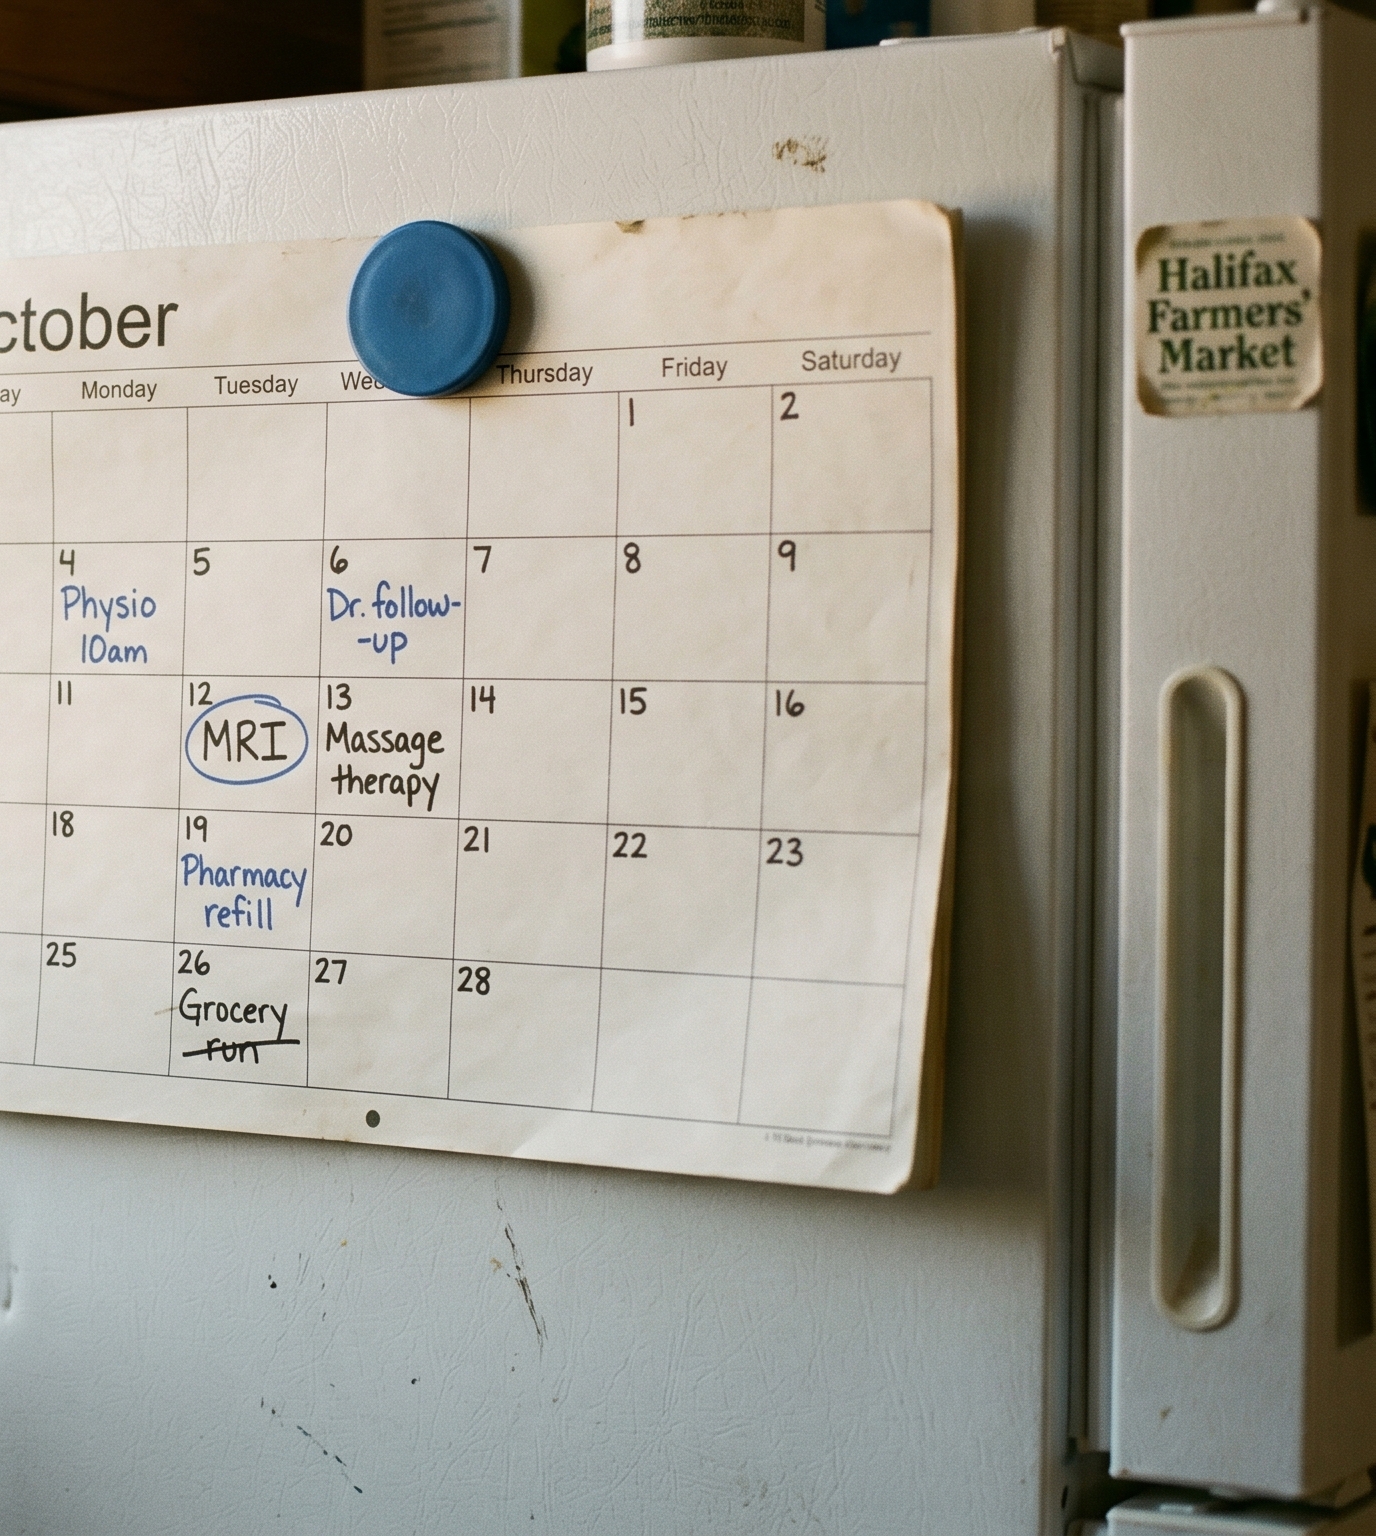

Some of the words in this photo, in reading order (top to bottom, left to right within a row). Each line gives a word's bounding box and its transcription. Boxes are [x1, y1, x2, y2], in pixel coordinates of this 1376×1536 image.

[1159, 250, 1298, 292] Halifax
[1147, 288, 1312, 334] Farmers'
[1158, 332, 1297, 374] Market
[81, 380, 157, 402] Monday
[214, 375, 299, 397] Tuesday
[496, 362, 593, 386] Thursday
[661, 356, 728, 380] Friday
[801, 347, 902, 373] Saturday
[628, 397, 635, 427] 1
[781, 391, 799, 420] 2
[59, 550, 75, 576] 4
[193, 547, 210, 576] 5
[330, 545, 348, 574] 6
[473, 546, 491, 573] 7
[624, 542, 641, 574] 8
[778, 540, 796, 571] 9
[61, 585, 156, 632] Physio
[327, 588, 365, 621] Dr.
[372, 580, 461, 619] follow-
[82, 634, 147, 663] 10am
[358, 632, 408, 664] -up
[58, 681, 72, 705] 11
[189, 681, 213, 706] 12
[328, 683, 352, 710] 13
[471, 685, 496, 714] 14
[621, 687, 647, 715] 15
[776, 690, 805, 717] 16
[204, 720, 287, 762] MRI
[326, 721, 445, 770] Massage
[331, 763, 440, 812] therapy
[53, 810, 74, 837] 18
[186, 815, 207, 842] 19
[320, 821, 353, 846] 20
[464, 826, 489, 853] 21
[613, 831, 647, 858] 22
[767, 837, 803, 867] 23
[181, 853, 307, 908] Pharmacy
[205, 894, 272, 930] refill
[46, 942, 76, 968] 25
[178, 950, 210, 976] 26
[315, 958, 347, 984] 27
[457, 966, 490, 995] 28
[178, 987, 288, 1041] Grocery
[206, 1037, 259, 1064] run
